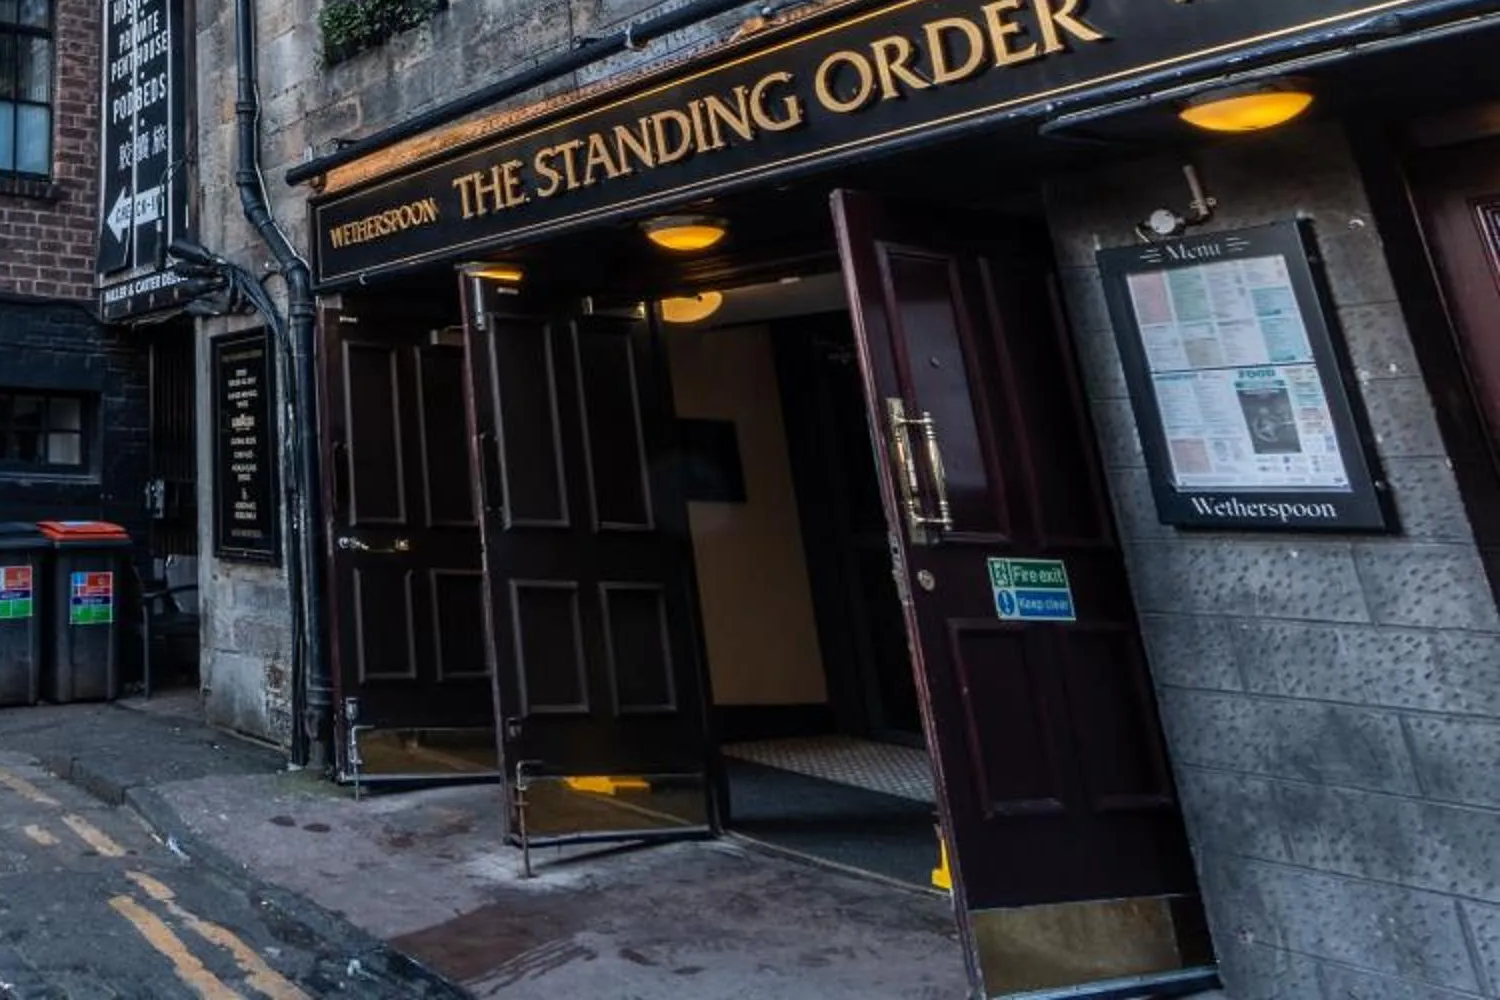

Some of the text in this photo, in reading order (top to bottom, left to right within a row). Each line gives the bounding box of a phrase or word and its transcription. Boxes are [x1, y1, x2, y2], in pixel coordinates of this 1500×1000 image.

[118, 10, 160, 55] PRVATE
[111, 30, 169, 83] PENTHOUSE
[453, 158, 530, 220] THE
[535, 71, 802, 198] STANDING
[330, 197, 439, 249] WETHERSPOON
[1165, 243, 1222, 261] Menu
[1191, 497, 1338, 522] Wetherspoon
[1012, 565, 1064, 584] Fire exit
